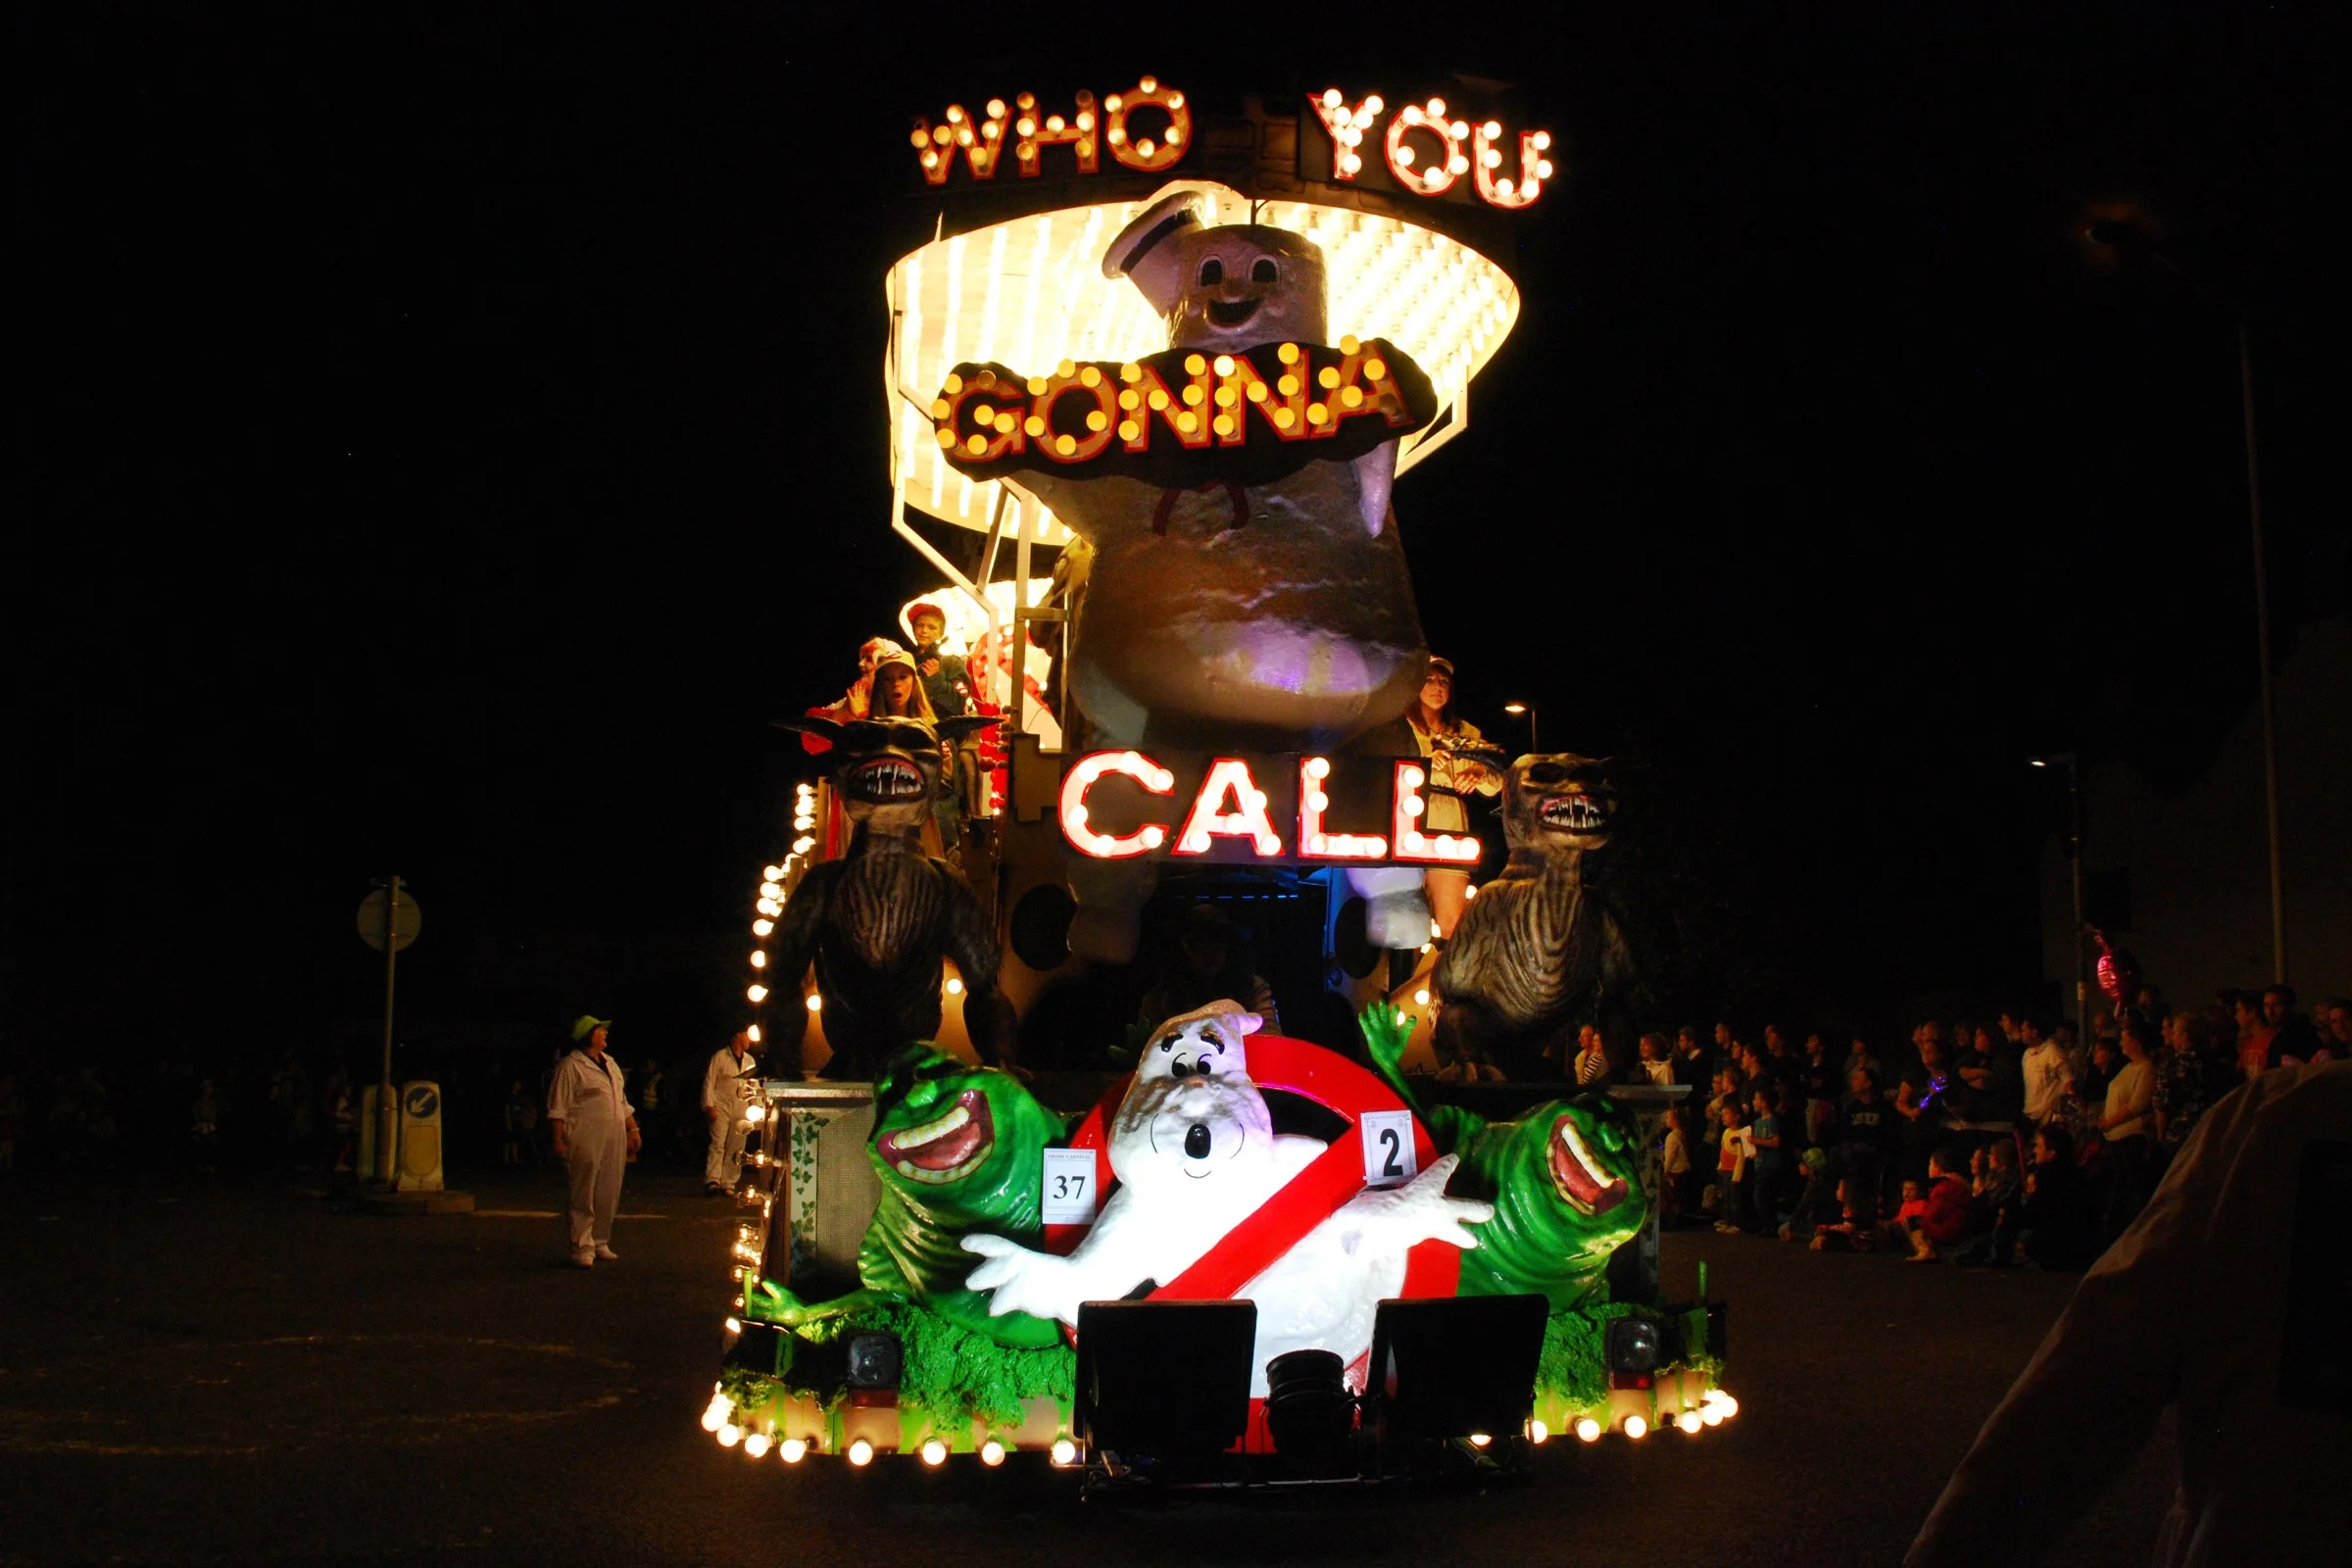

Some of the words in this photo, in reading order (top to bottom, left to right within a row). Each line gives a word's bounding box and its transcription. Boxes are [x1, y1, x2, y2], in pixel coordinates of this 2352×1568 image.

[910, 75, 1193, 184] WHO
[1306, 88, 1551, 209] YOU
[932, 334, 1415, 463] GONNA
[1057, 750, 1482, 863] CALL
[1053, 1175, 1086, 1200] 37
[1380, 1128, 1403, 1177] 2
